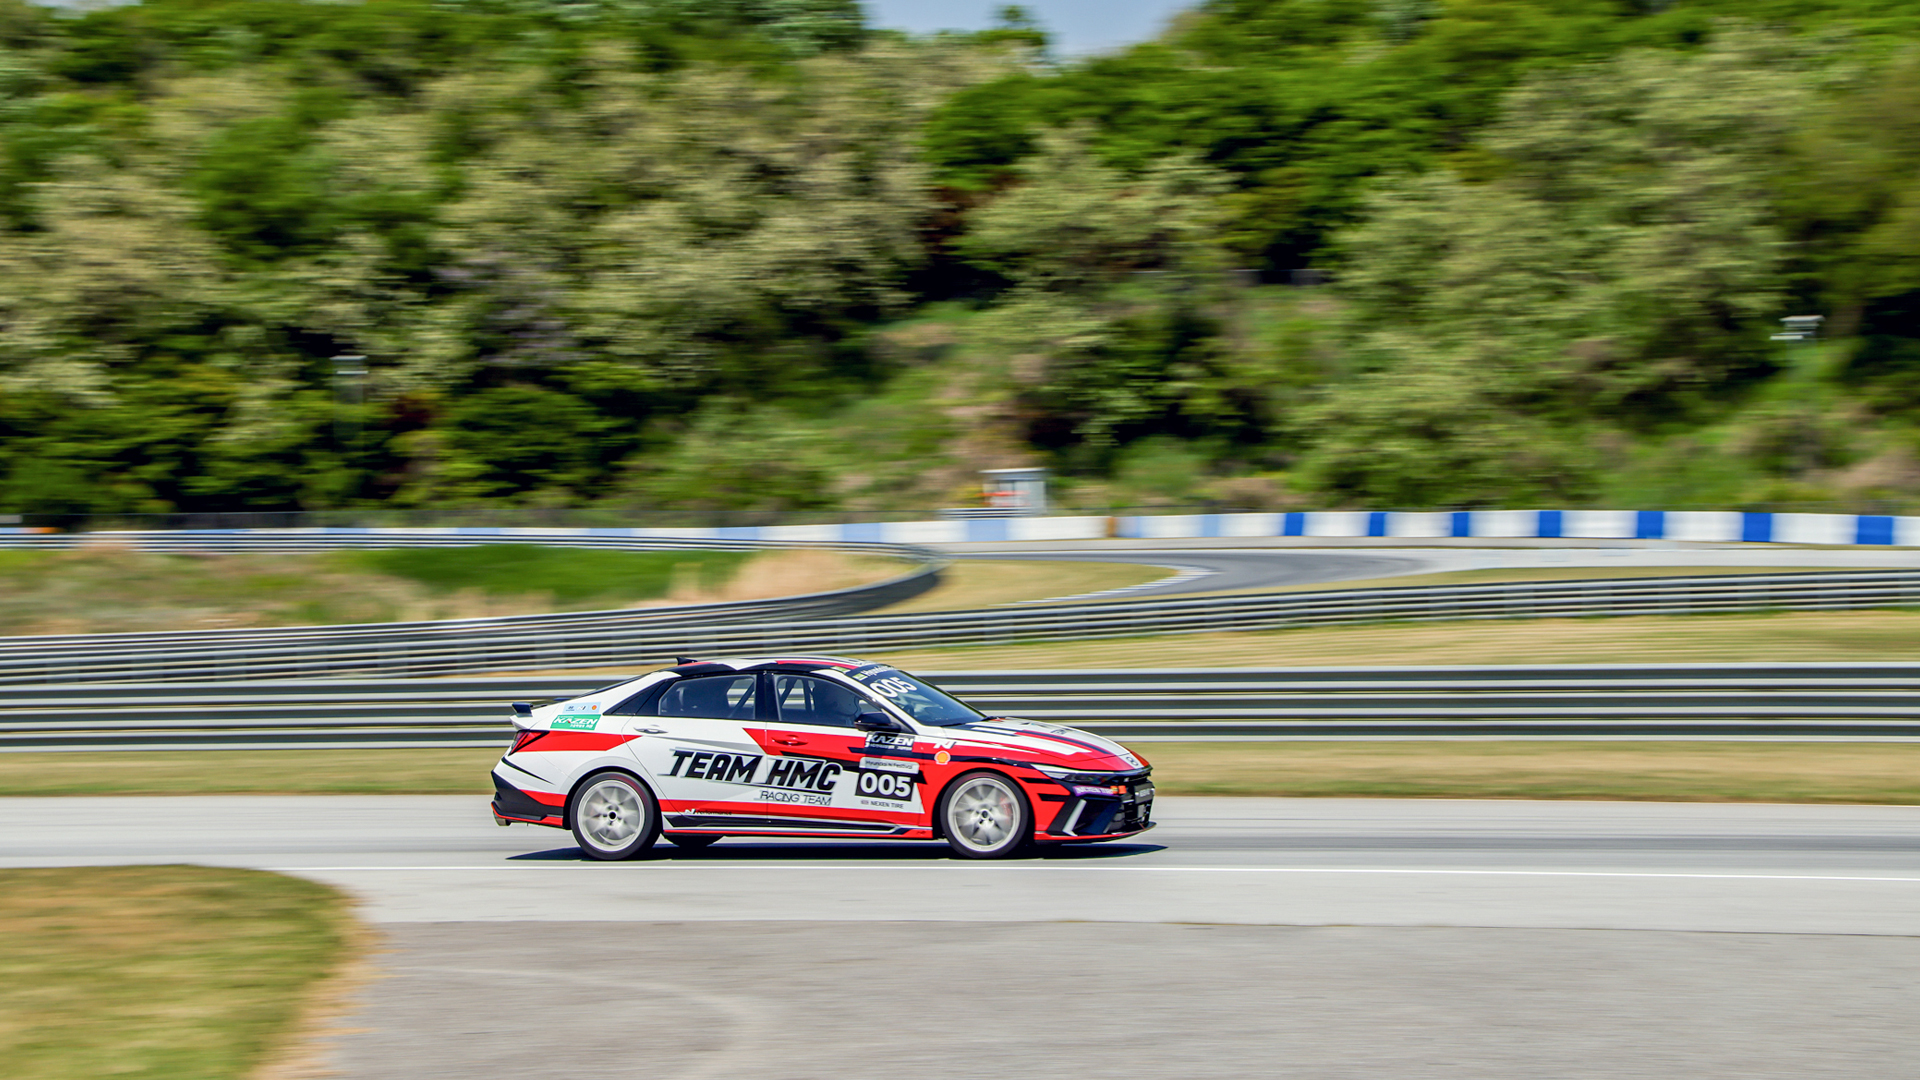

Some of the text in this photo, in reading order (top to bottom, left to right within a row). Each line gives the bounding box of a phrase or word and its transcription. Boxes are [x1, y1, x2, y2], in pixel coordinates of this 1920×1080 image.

[870, 677, 917, 697] 005
[554, 716, 598, 724] KAZEN
[866, 734, 914, 746] KAZEN
[669, 750, 841, 790] TEAM HMC
[860, 772, 911, 797] 005
[760, 791, 832, 806] RACING TEAM
